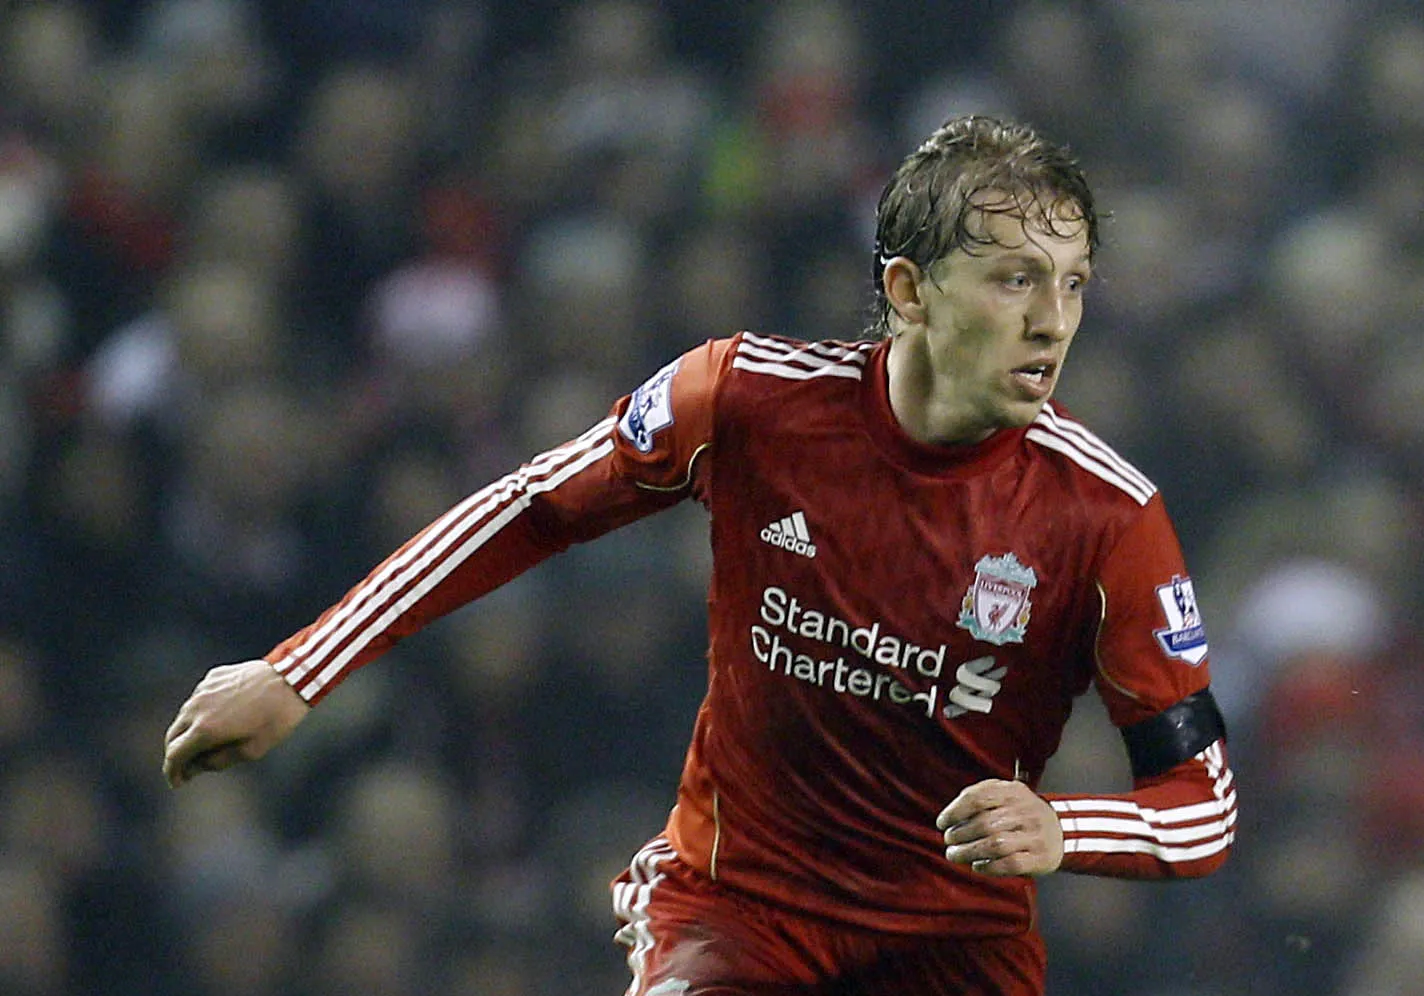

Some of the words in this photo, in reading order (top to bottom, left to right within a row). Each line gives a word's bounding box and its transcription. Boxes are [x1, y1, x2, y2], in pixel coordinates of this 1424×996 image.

[760, 528, 816, 559] adidas
[752, 625, 937, 718] Chartered
[761, 587, 946, 677] Standard
